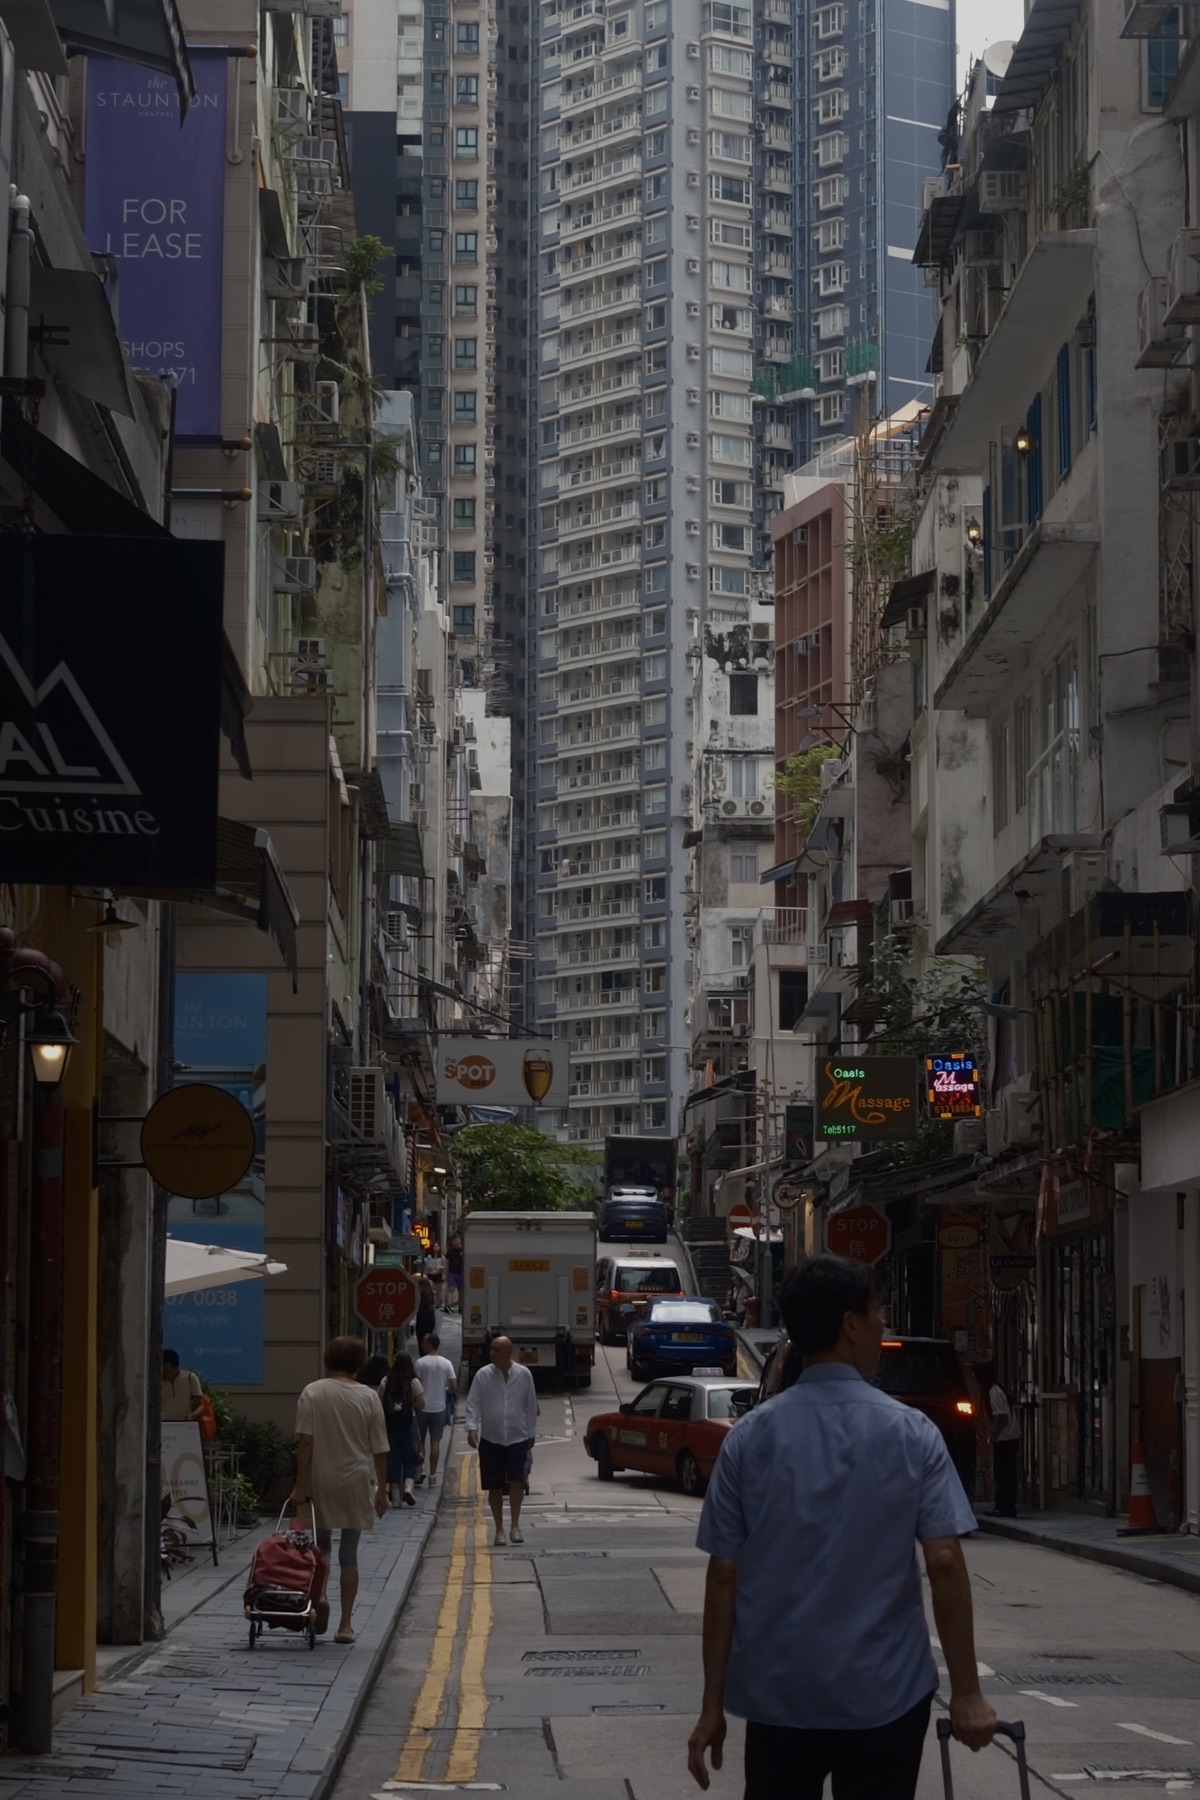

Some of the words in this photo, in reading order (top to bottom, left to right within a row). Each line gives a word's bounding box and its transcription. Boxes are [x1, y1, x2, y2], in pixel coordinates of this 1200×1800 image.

[147, 76, 167, 92] the
[139, 110, 174, 118] CENTRAL
[123, 198, 187, 225] FOR
[106, 233, 202, 259] LEASE
[0, 796, 161, 836] Cuisine
[444, 1064, 494, 1081] SPOT
[833, 1068, 865, 1078] Oasis
[934, 1059, 973, 1071] Oasis
[934, 1071, 974, 1093] Massage
[822, 1061, 911, 1124] Massage
[836, 1218, 879, 1231] STOP
[849, 1239, 866, 1257] 停
[991, 1257, 1035, 1267] GUINNESS
[194, 1289, 238, 1306] 0038
[366, 1282, 407, 1296] STOP
[378, 1302, 396, 1321] 停
